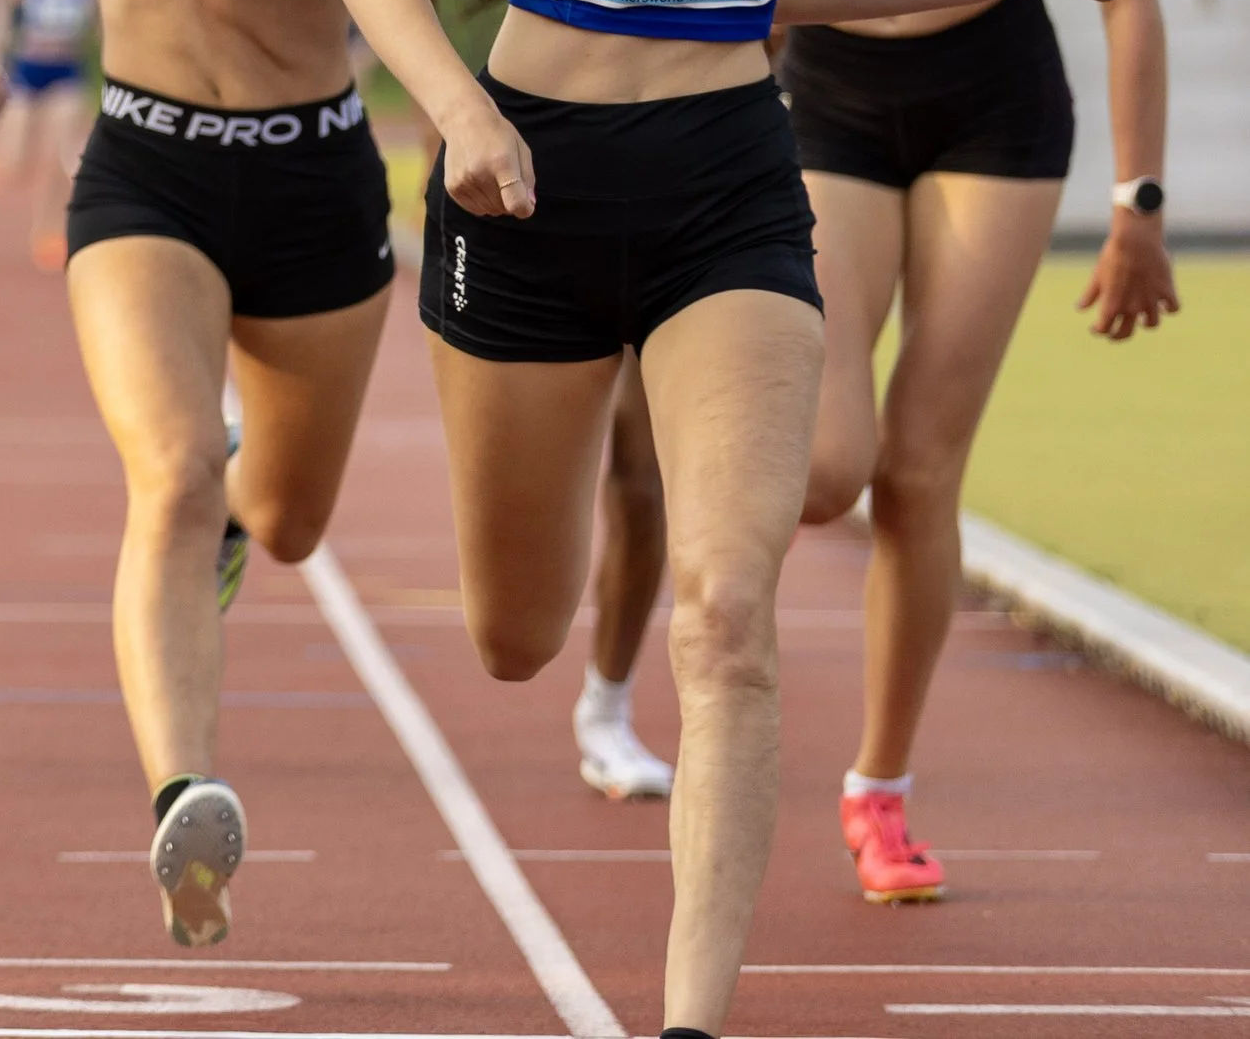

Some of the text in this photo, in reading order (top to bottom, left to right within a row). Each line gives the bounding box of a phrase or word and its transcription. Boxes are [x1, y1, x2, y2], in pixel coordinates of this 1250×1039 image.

[100, 82, 184, 136] NIKE
[184, 112, 303, 147] PRO
[454, 235, 467, 296] CRAFT
